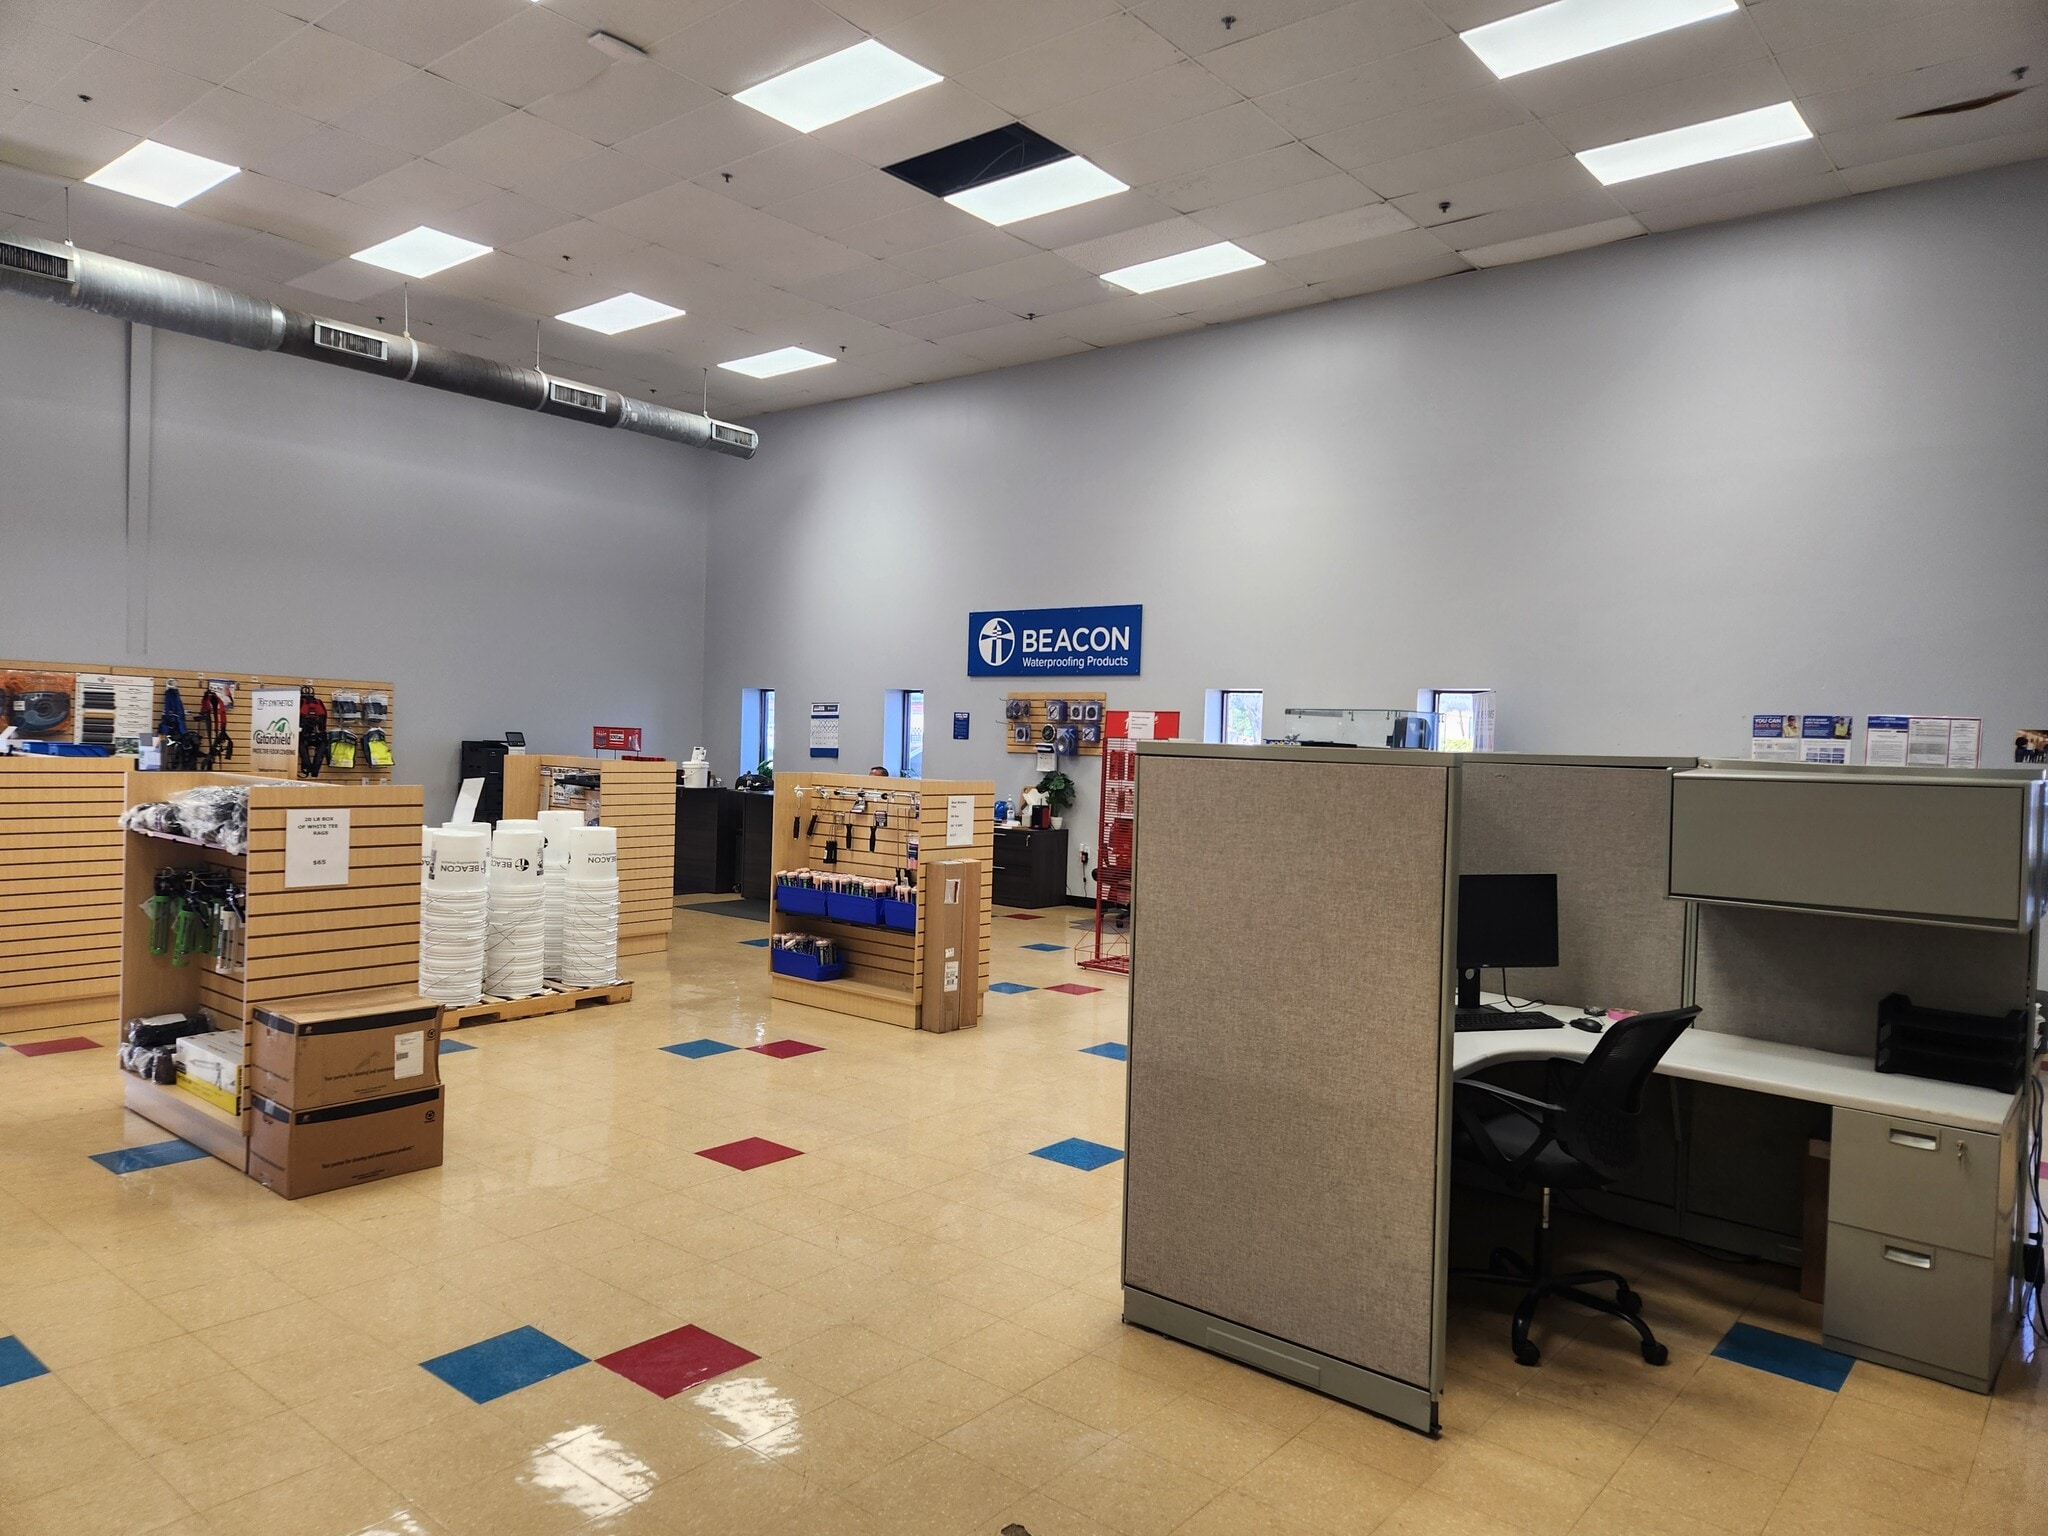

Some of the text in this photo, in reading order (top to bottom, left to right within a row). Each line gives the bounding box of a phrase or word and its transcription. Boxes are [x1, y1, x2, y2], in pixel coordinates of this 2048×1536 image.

[1022, 626, 1130, 653] BEACON
[1022, 655, 1129, 669] Waterproofing Products
[440, 864, 480, 873] BEACON
